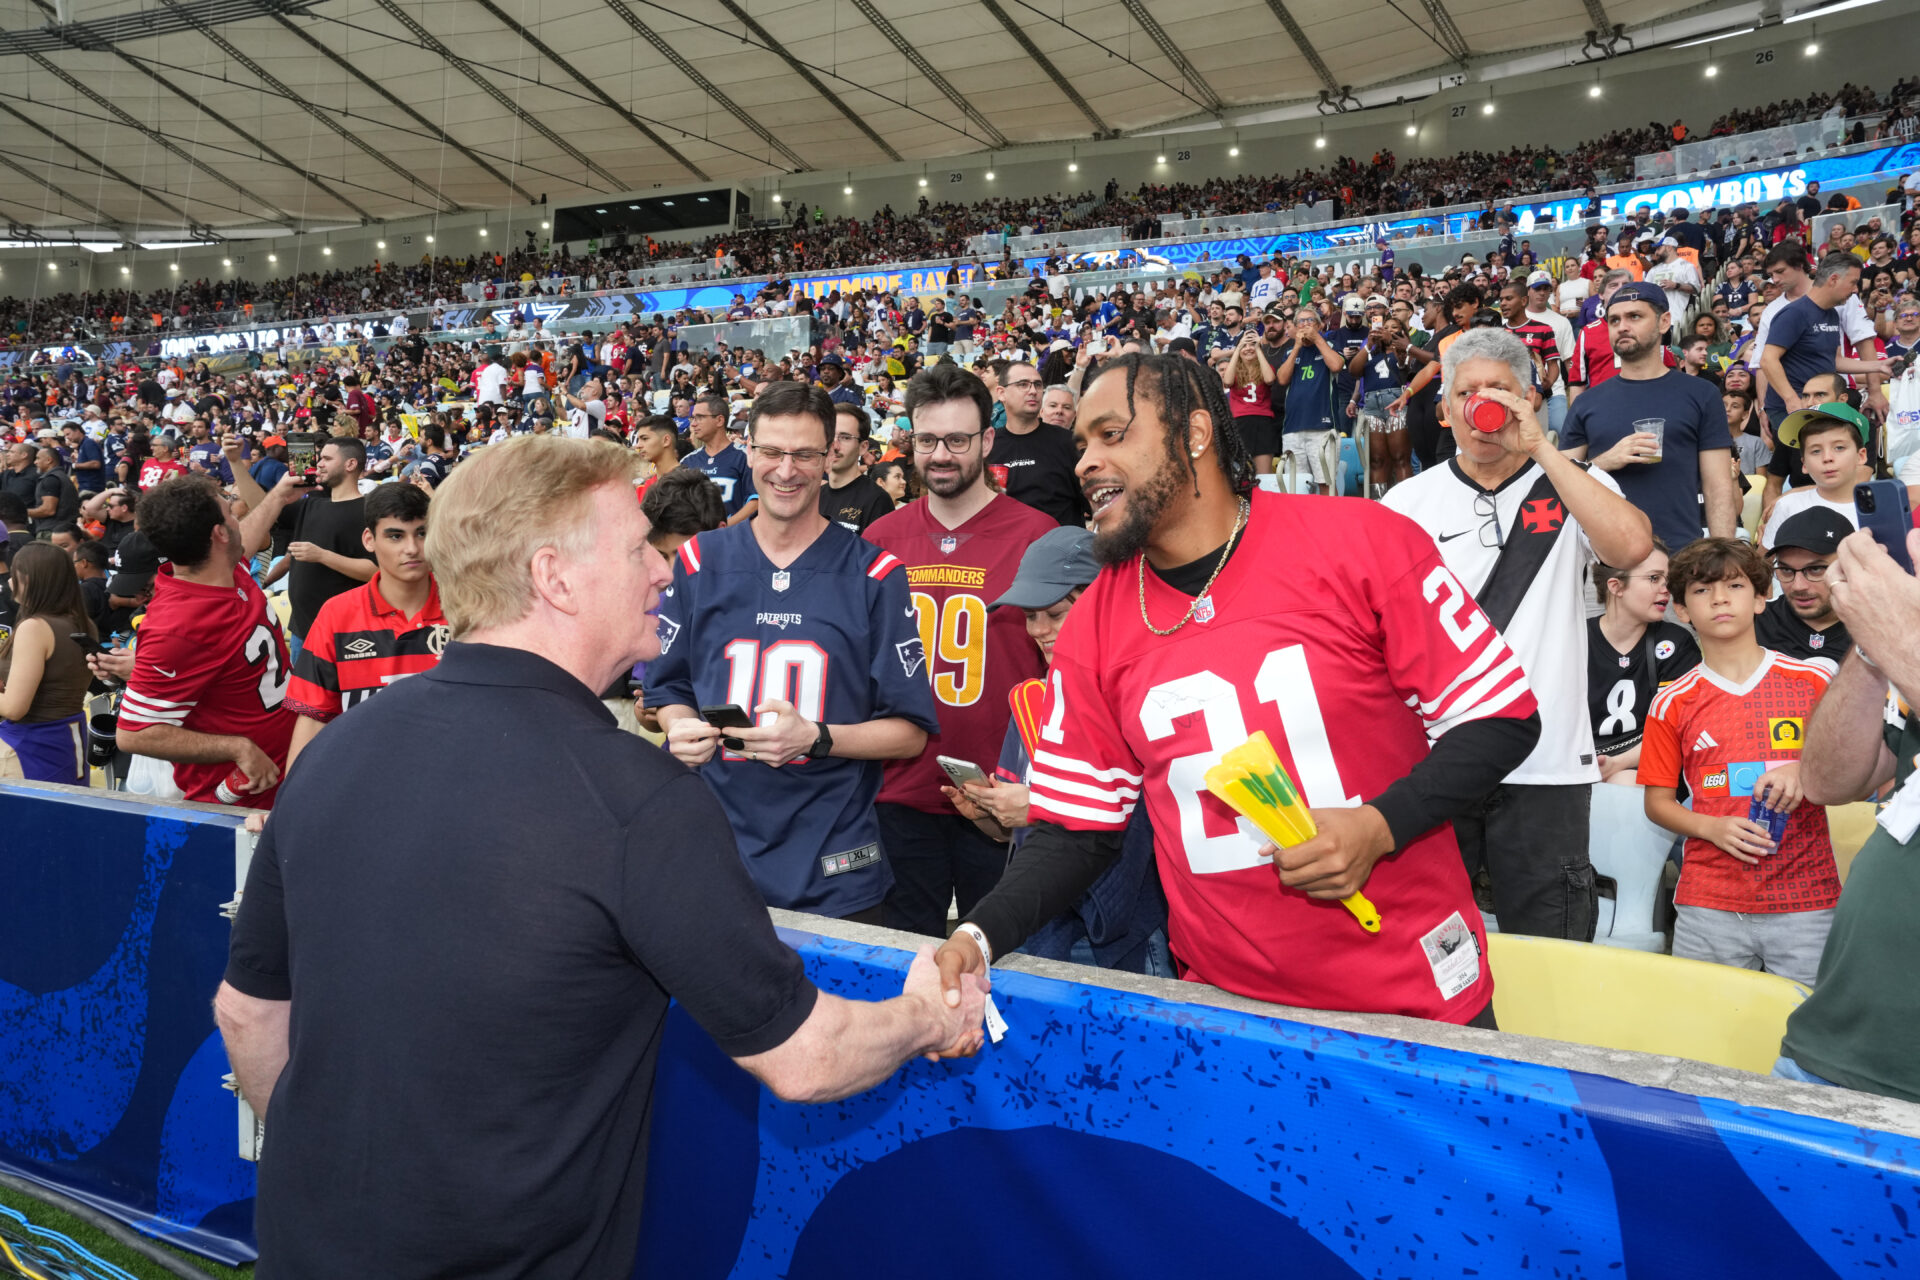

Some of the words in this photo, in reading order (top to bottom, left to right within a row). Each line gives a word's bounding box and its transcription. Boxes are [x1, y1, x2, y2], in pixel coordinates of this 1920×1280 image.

[1755, 50, 1774, 65] 26
[1451, 105, 1466, 117] 27
[1177, 151, 1191, 161] 28
[950, 173, 962, 183] 29
[1624, 169, 1807, 216] COWBOYS
[1253, 283, 1270, 298] 12
[1301, 364, 1315, 381] 76
[1374, 359, 1390, 379] 4
[1242, 382, 1257, 403] 3
[138, 467, 163, 487] 38
[906, 567, 985, 585] COMMANDERS
[756, 612, 802, 625] PATRIOTS
[722, 638, 829, 764] 10
[1598, 679, 1638, 736] 8
[1139, 643, 1362, 874] 21
[1703, 773, 1727, 788] LEGO
[853, 850, 866, 860] XL
